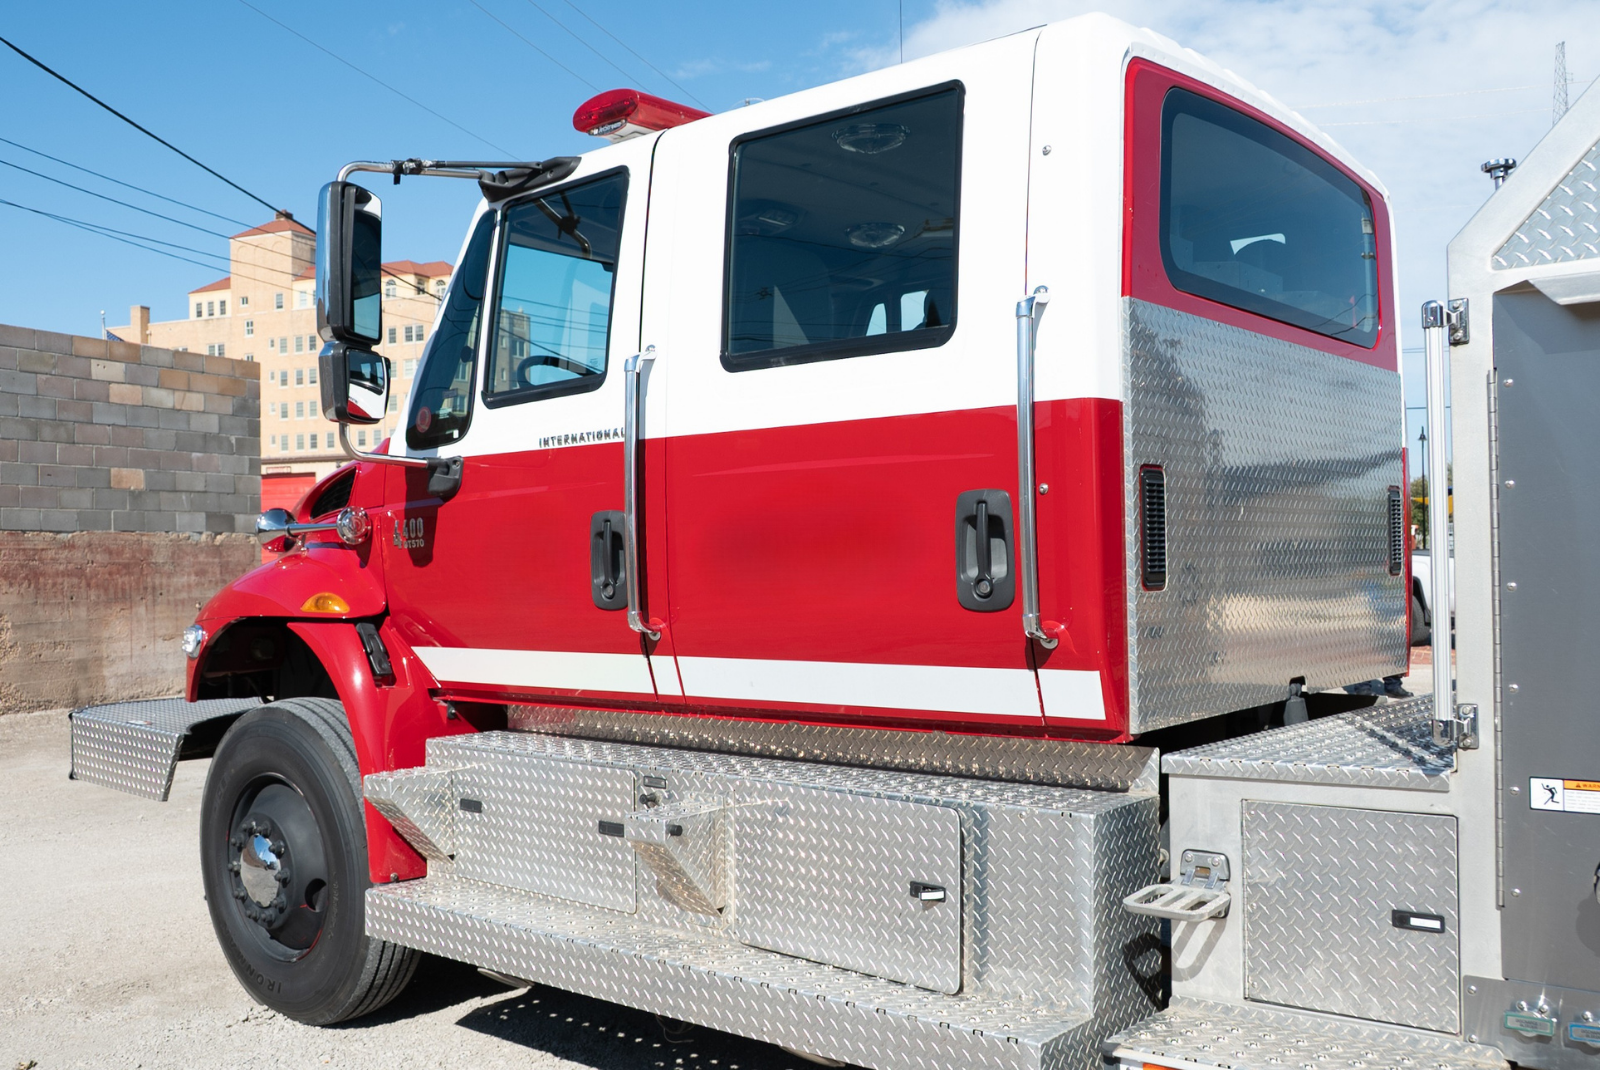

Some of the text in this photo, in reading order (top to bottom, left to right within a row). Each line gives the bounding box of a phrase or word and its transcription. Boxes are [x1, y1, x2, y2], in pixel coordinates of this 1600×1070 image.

[539, 427, 625, 448] INTERNATIONAL
[393, 517, 424, 549] 4400
[218, 922, 282, 995] IRONMAN
